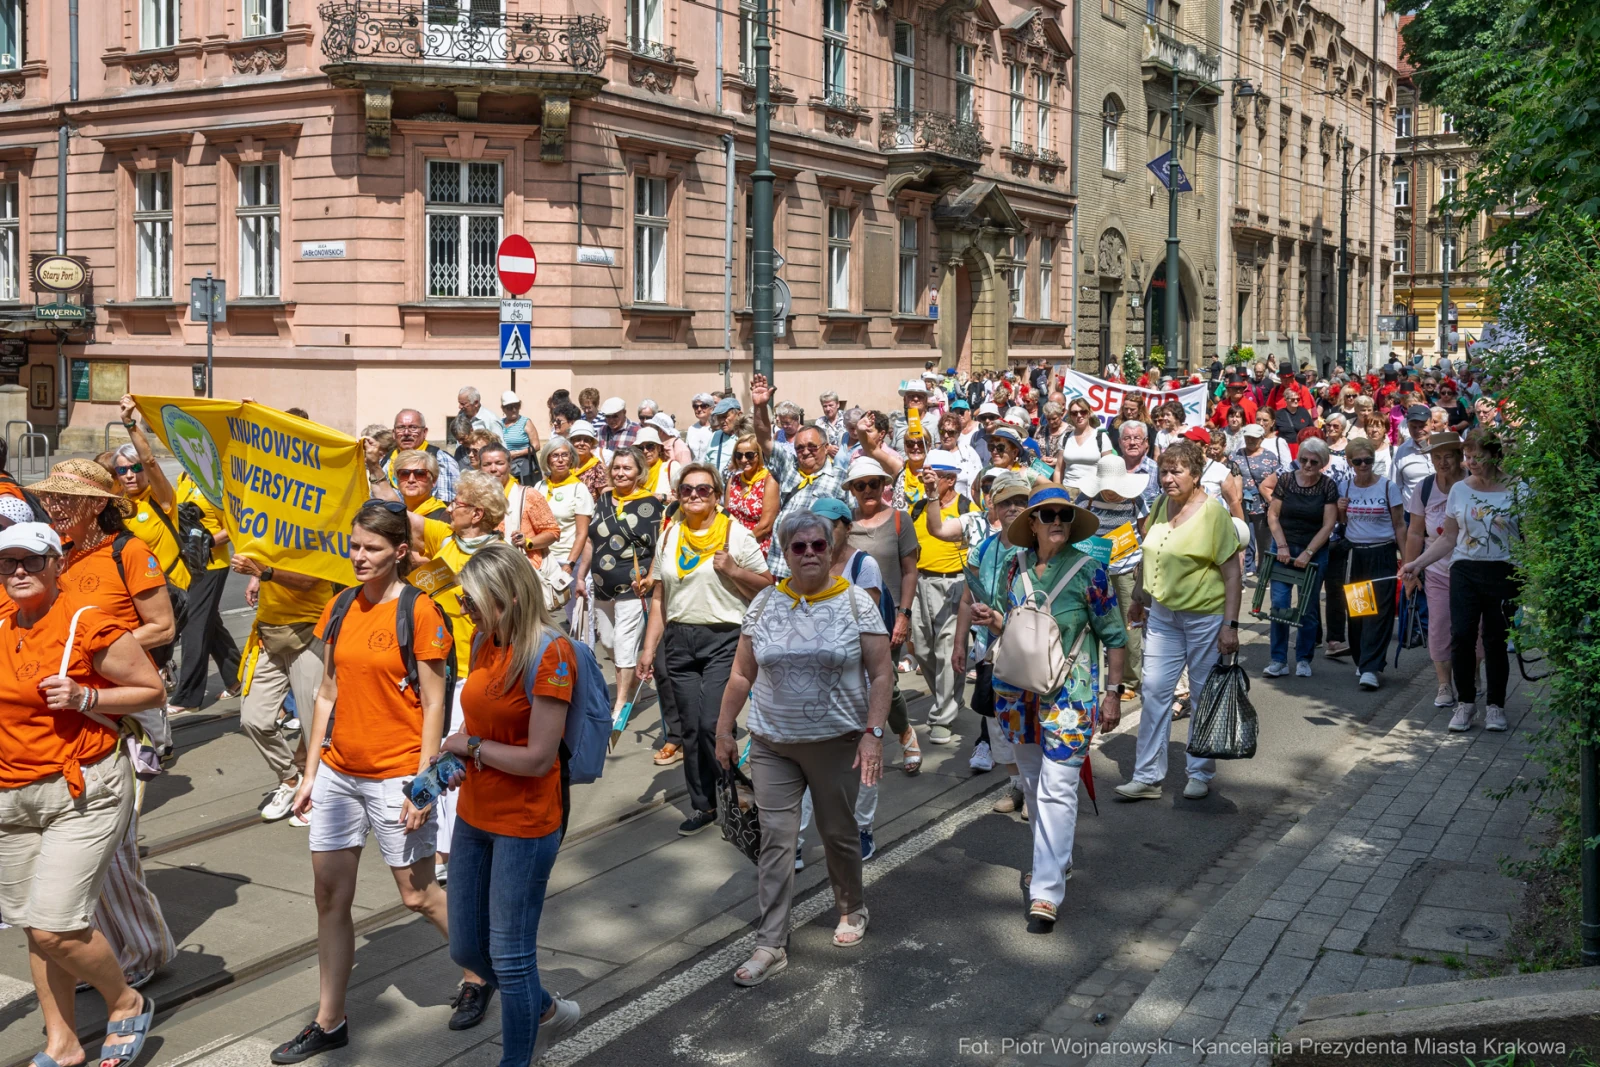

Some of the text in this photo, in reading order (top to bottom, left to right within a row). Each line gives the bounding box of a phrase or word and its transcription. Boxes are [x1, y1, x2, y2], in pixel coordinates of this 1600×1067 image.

[302, 248, 344, 257] JABŁONOWSKICH
[43, 270, 74, 282] Stary Port
[512, 301, 532, 309] dotyczy
[40, 308, 83, 316] TAWERNA
[226, 416, 321, 470] KNUROWSKI
[274, 518, 351, 559] WIEKU
